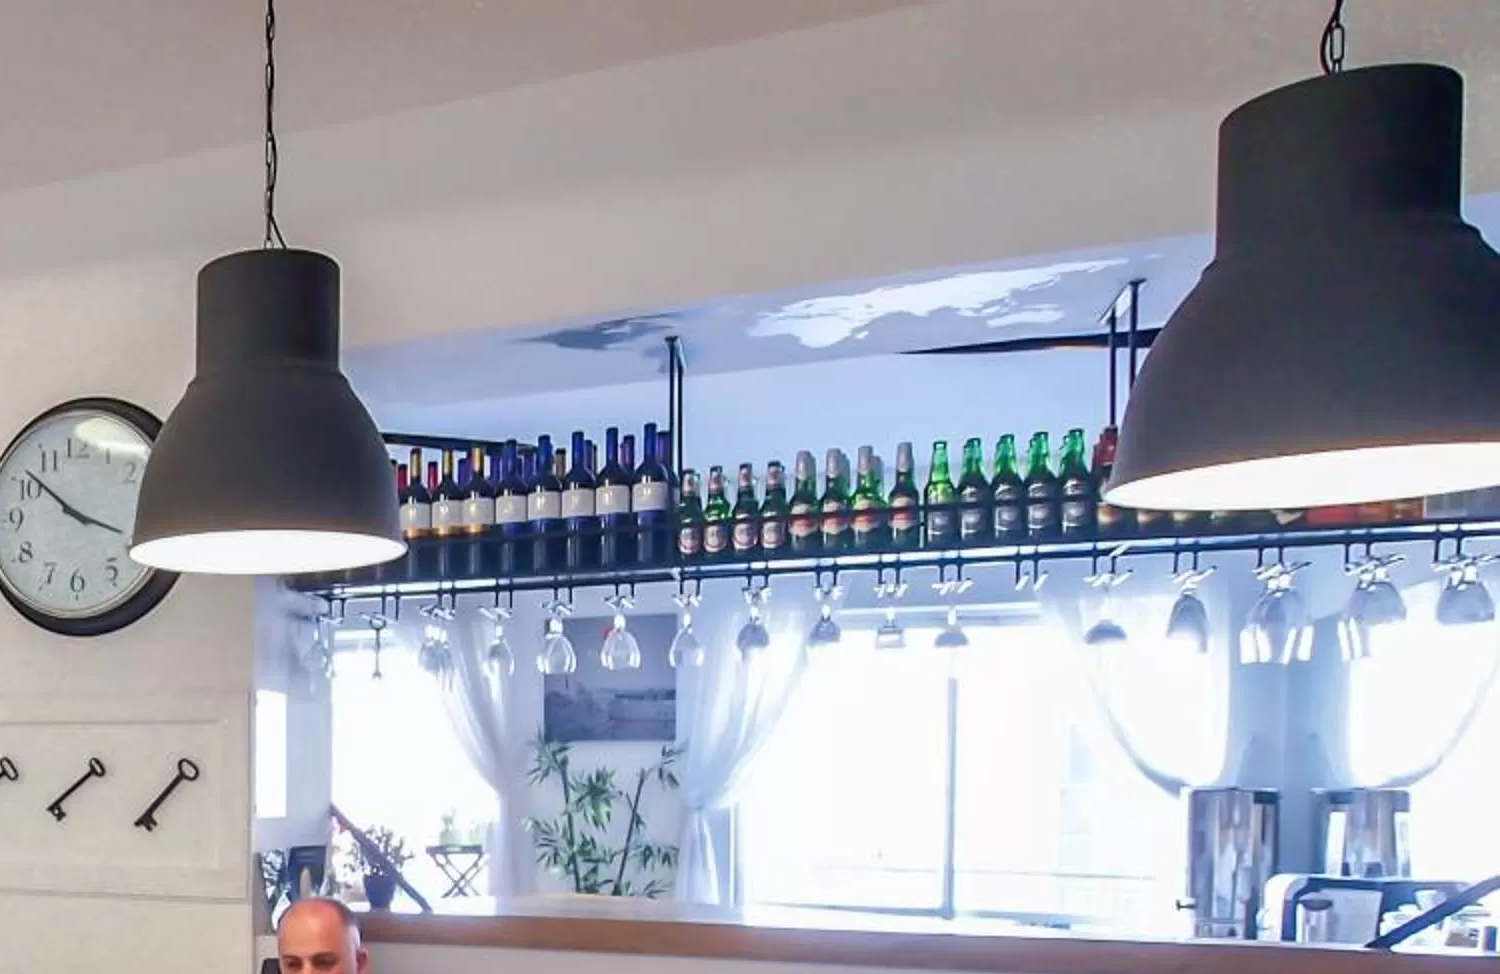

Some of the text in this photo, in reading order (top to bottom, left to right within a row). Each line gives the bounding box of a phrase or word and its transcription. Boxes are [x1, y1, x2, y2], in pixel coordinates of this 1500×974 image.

[66, 437, 91, 458] 12
[40, 449, 58, 472] 11
[122, 461, 137, 484] 2
[19, 478, 43, 501] 10
[8, 507, 25, 532] 9
[18, 541, 34, 564] 8
[43, 561, 57, 585] 7
[69, 567, 86, 593] 6
[105, 557, 119, 582] 5
